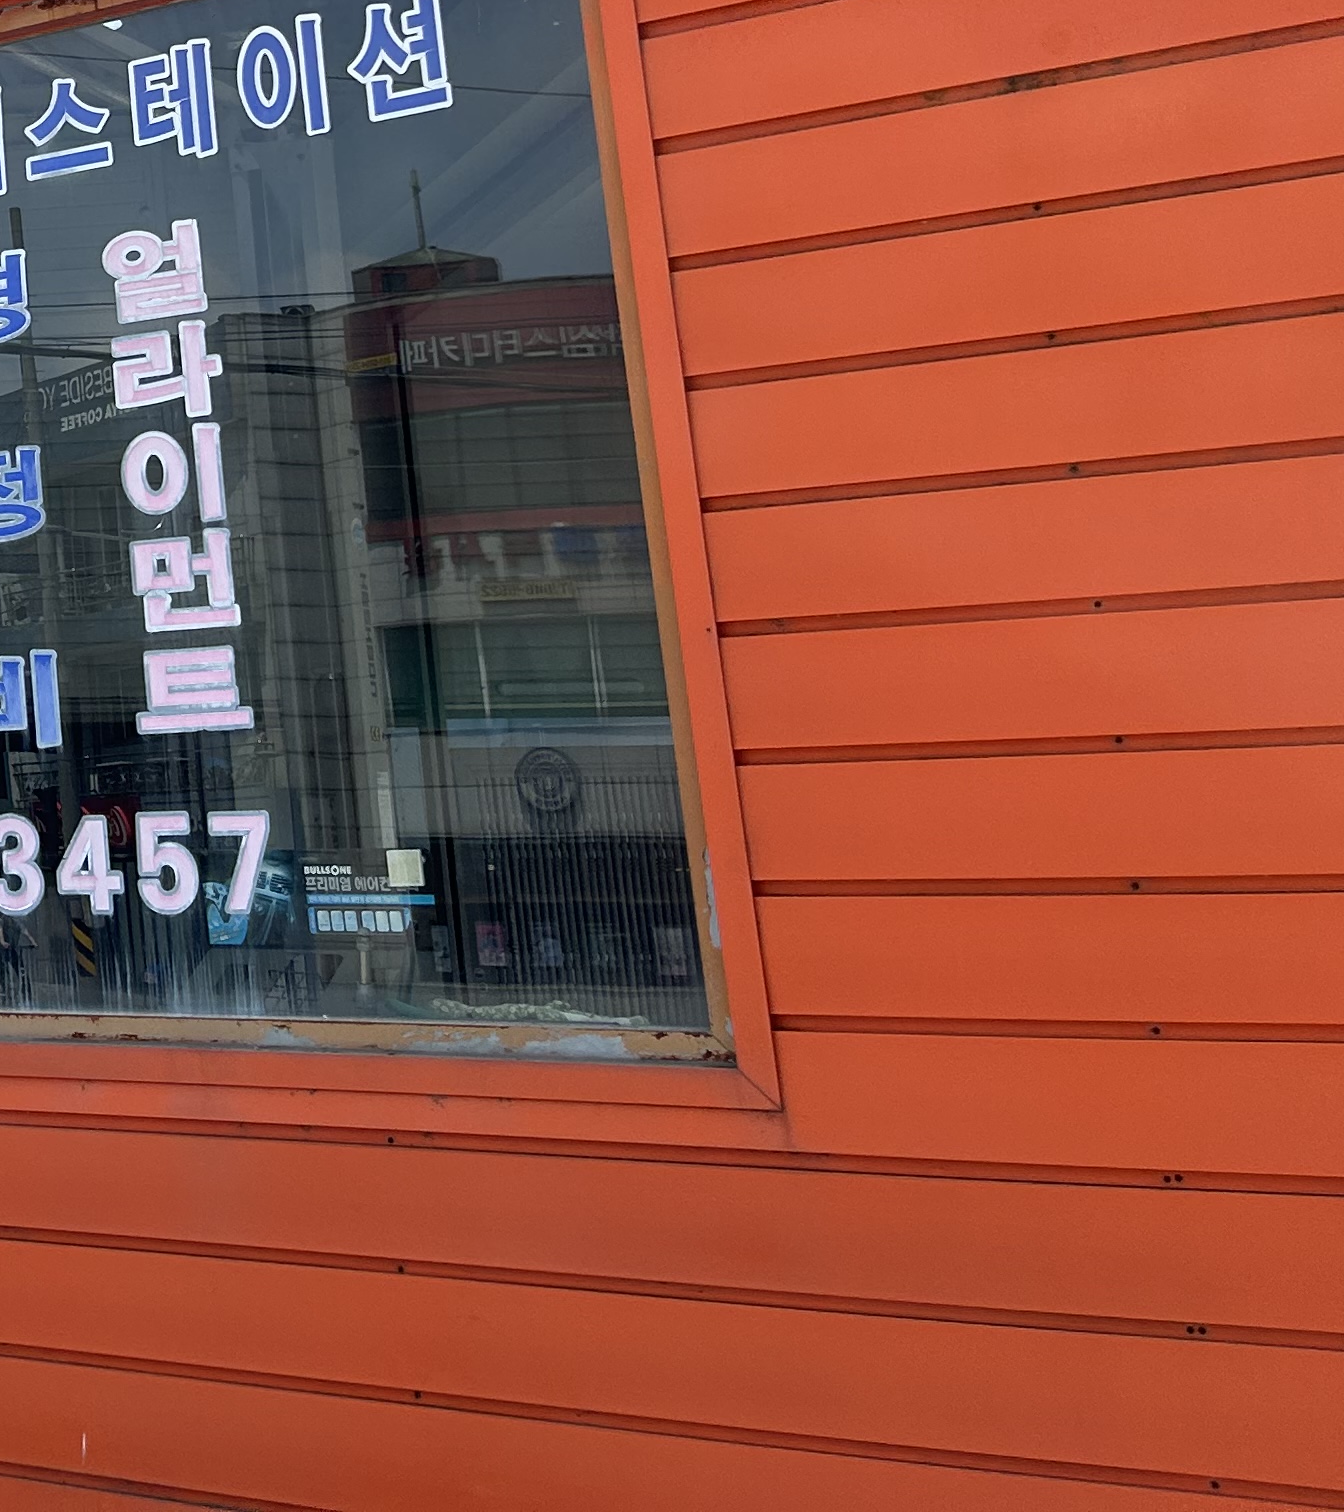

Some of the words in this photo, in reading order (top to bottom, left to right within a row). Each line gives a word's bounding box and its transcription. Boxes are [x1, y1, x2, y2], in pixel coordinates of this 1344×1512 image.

[101, 217, 255, 735] 얼라이먼트
[303, 865, 352, 876] BULLSONE
[305, 876, 352, 891] 프리미엄
[354, 876, 393, 891] 에어컨
